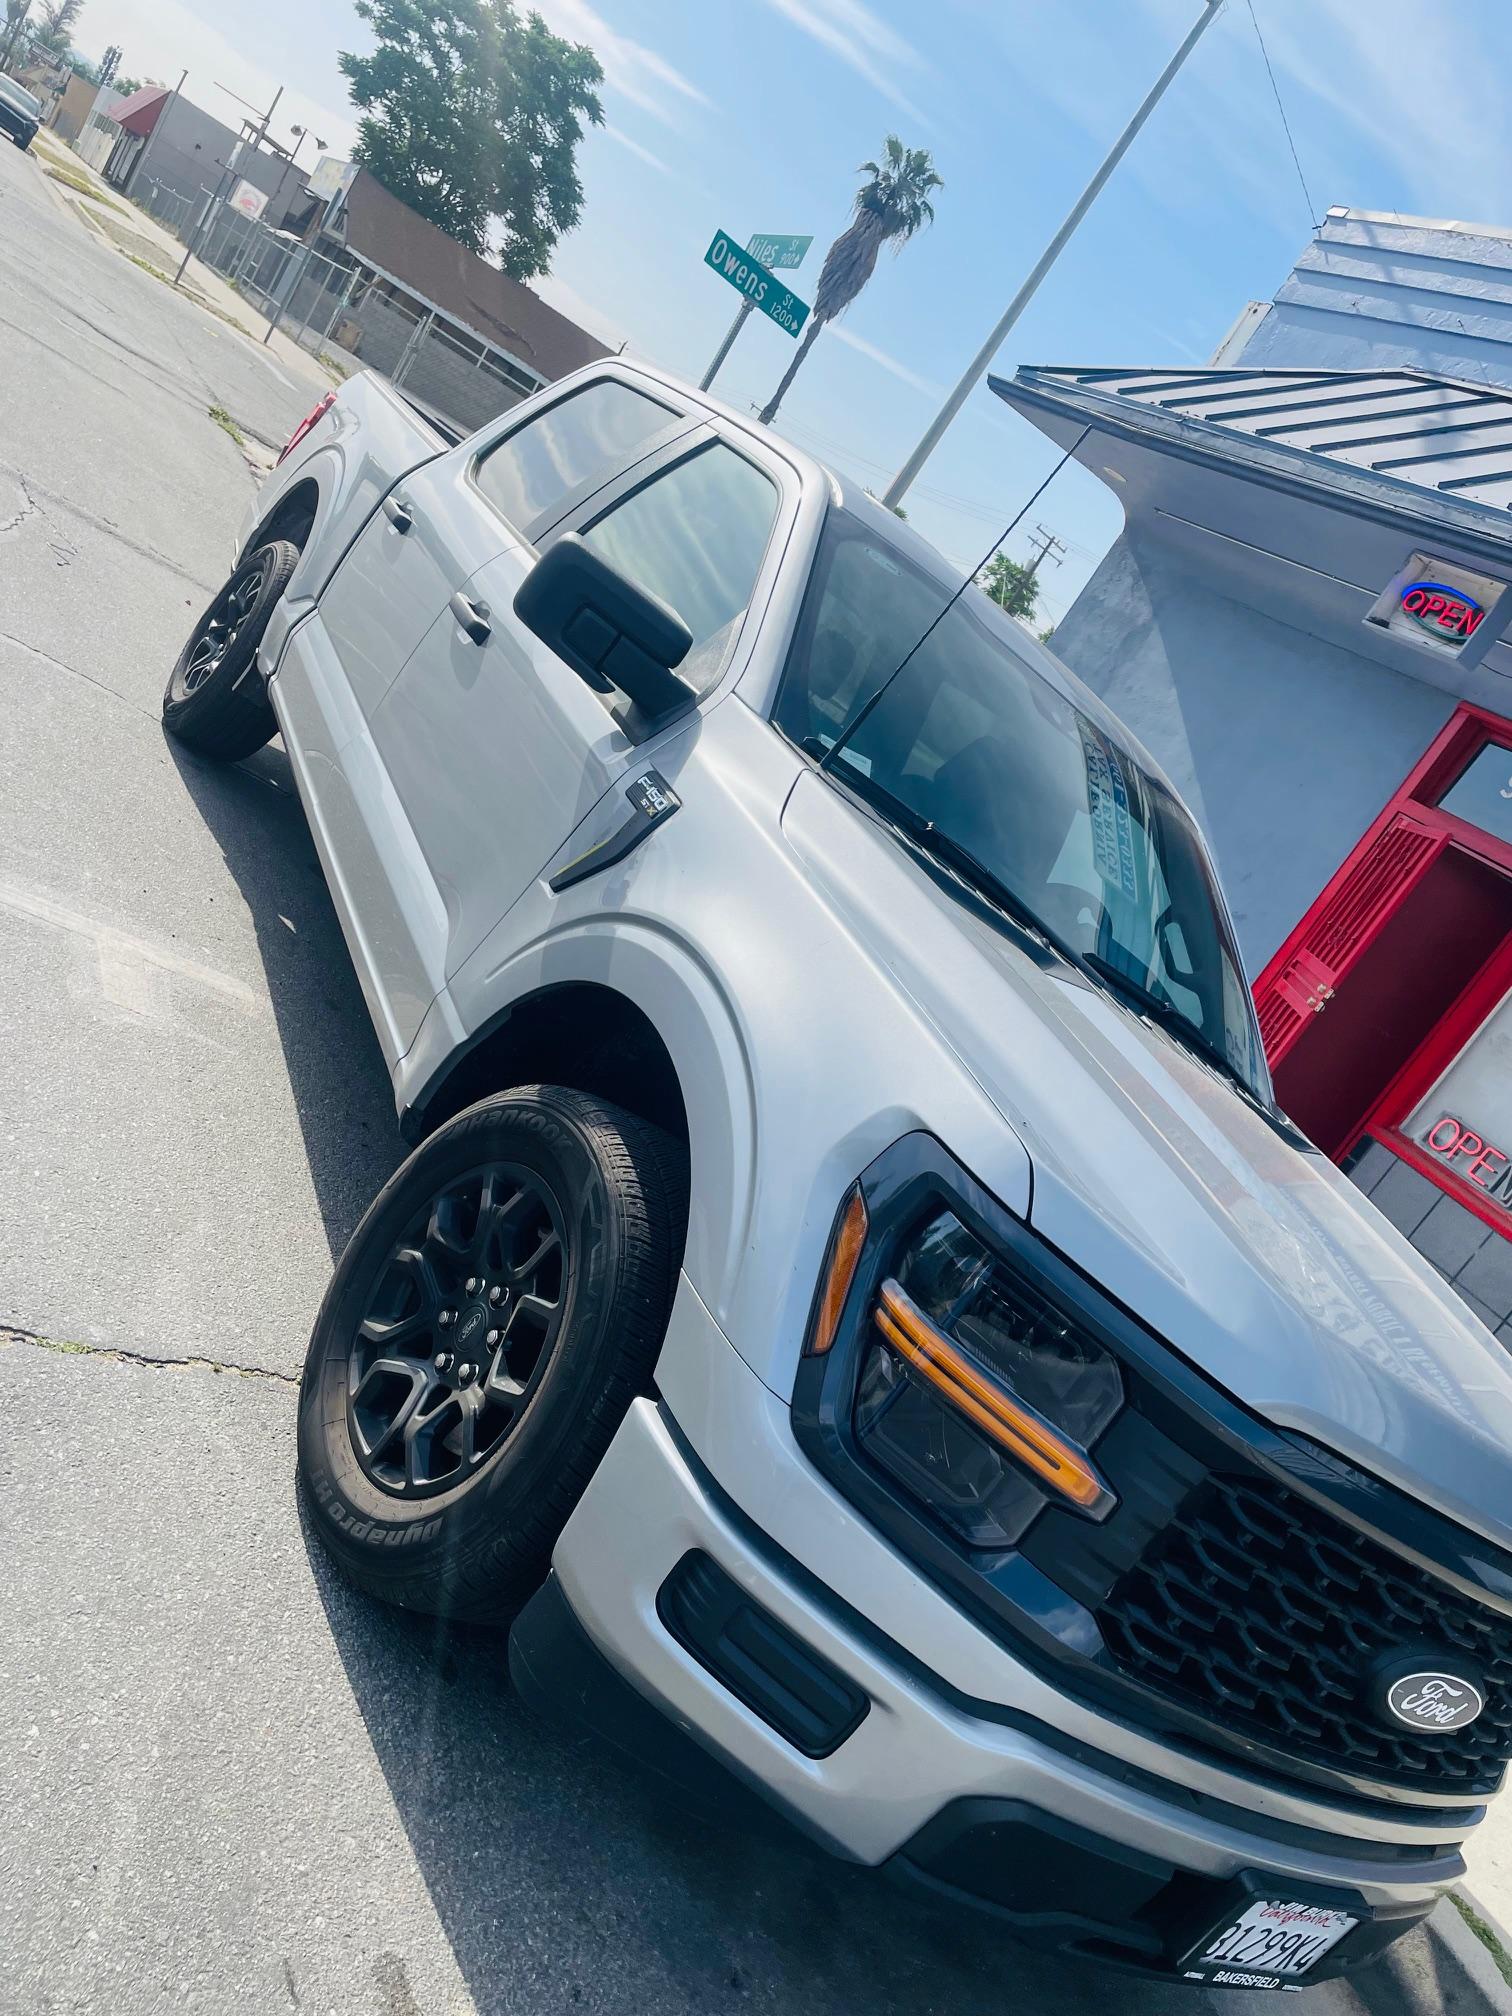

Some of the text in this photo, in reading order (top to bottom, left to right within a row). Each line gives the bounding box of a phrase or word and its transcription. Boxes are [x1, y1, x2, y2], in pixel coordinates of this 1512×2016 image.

[748, 238, 779, 263] Niles
[779, 253, 796, 265] 900
[711, 239, 794, 309] Owens St
[769, 302, 792, 327] 1200
[1402, 590, 1484, 636] OPEN
[637, 776, 668, 811] F-150
[640, 798, 659, 817] STX
[328, 1501, 443, 1545] Dynapro
[1400, 1679, 1469, 1724] Ford
[1212, 1970, 1280, 1989] BAKERSFIELD
